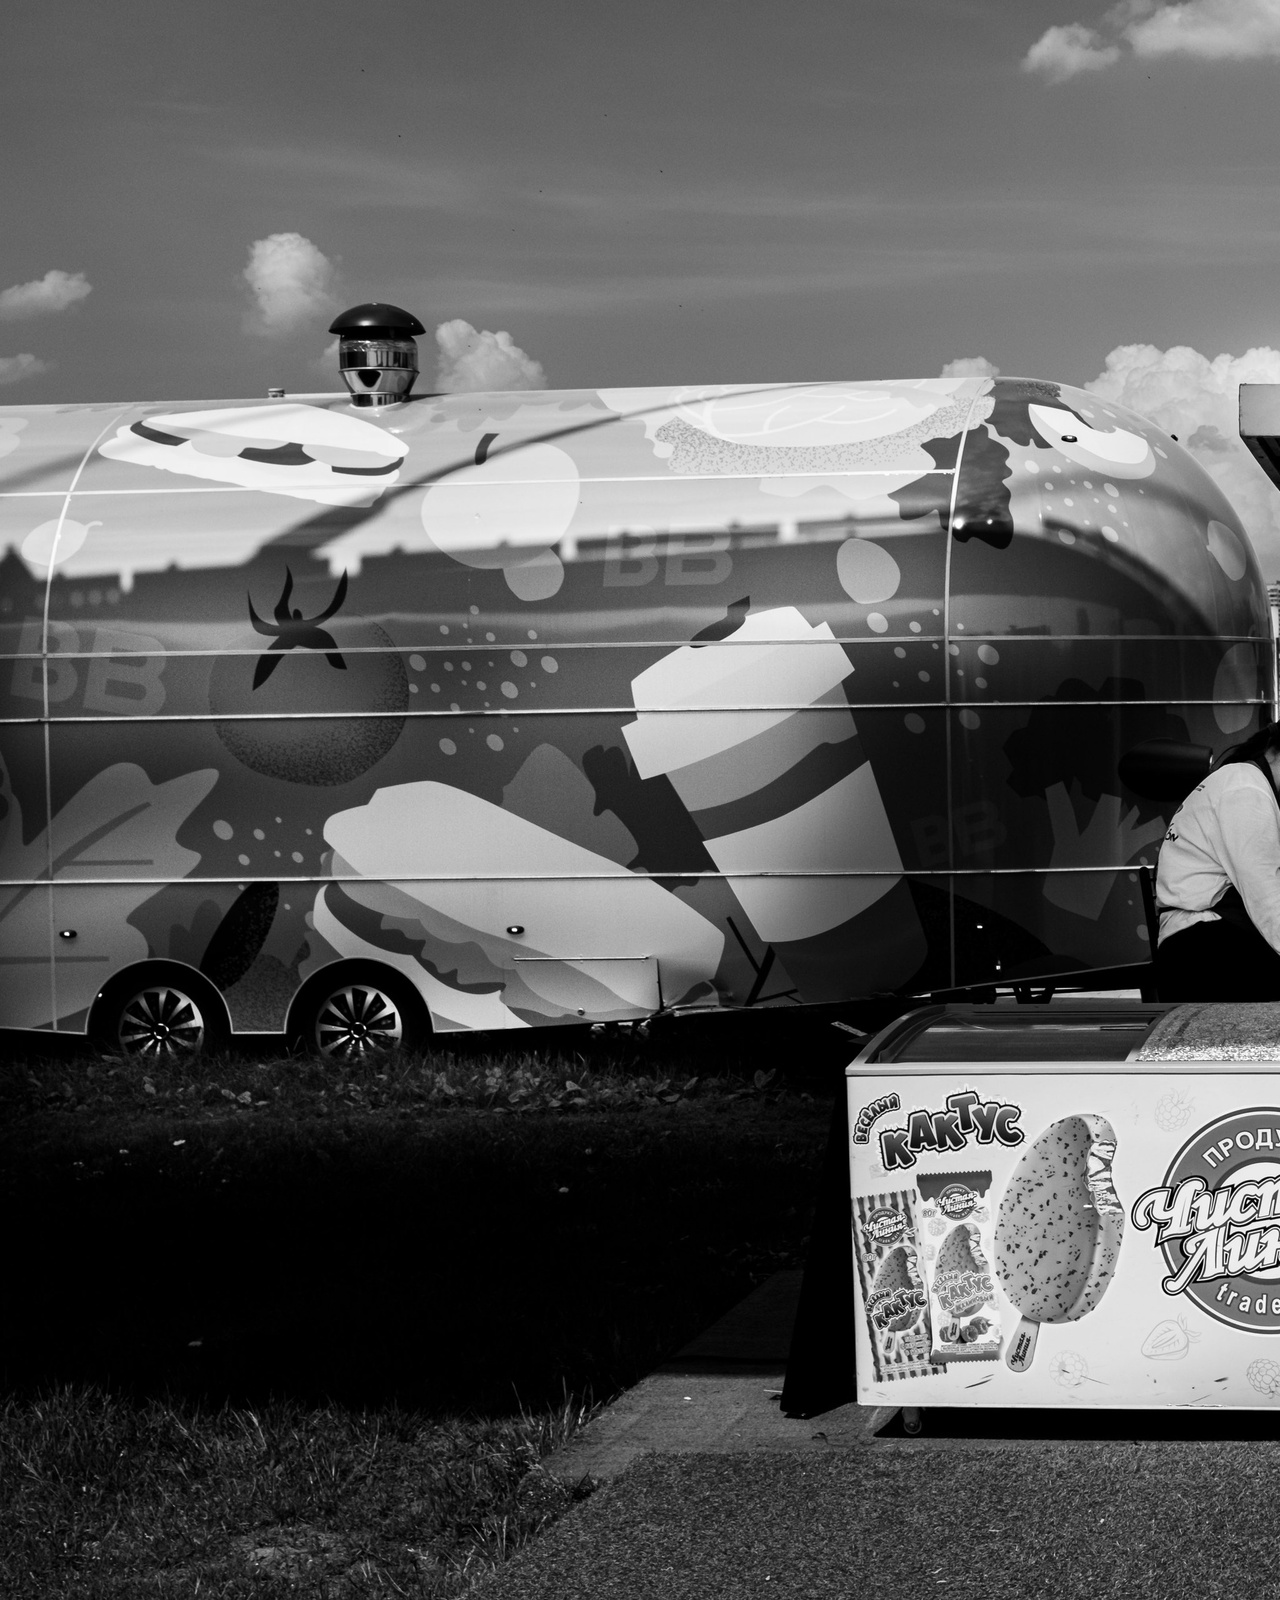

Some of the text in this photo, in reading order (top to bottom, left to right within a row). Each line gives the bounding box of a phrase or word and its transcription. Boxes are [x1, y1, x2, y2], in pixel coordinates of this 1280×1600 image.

[879, 1090, 1025, 1171] КАКТУС
[872, 1289, 928, 1331] КАКТУС
[938, 1272, 994, 1311] КАКТУС
[1010, 1331, 1026, 1366] Чистая
[1018, 1335, 1032, 1367] Линия
